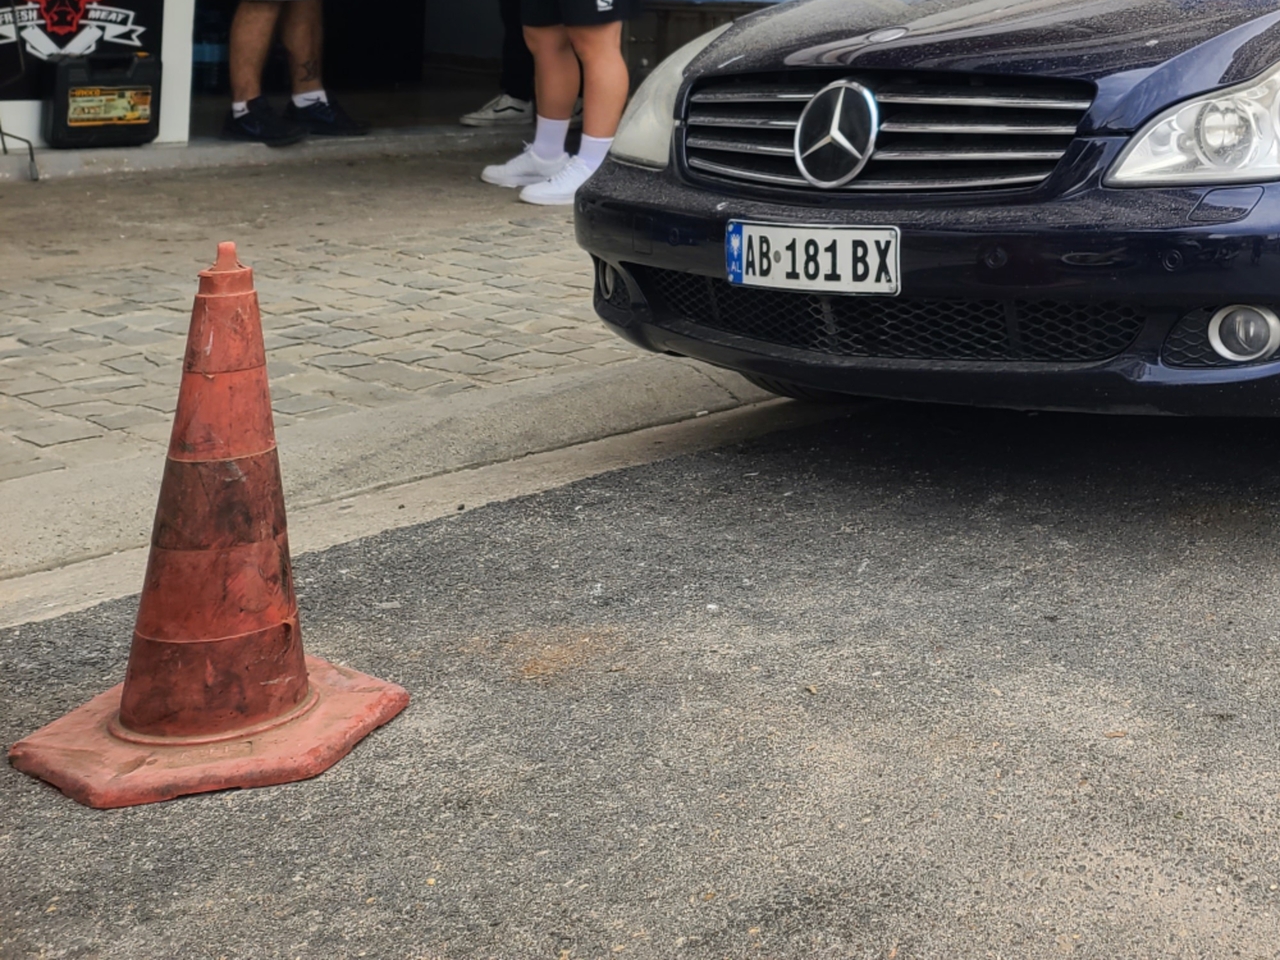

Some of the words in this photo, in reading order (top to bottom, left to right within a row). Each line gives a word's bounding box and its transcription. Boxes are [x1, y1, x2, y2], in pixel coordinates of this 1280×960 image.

[0, 9, 38, 25] FRESH
[87, 9, 126, 23] MEAT
[731, 262, 742, 273] AL
[745, 234, 772, 277] AB
[785, 237, 842, 282] 181
[852, 239, 893, 283] BX
